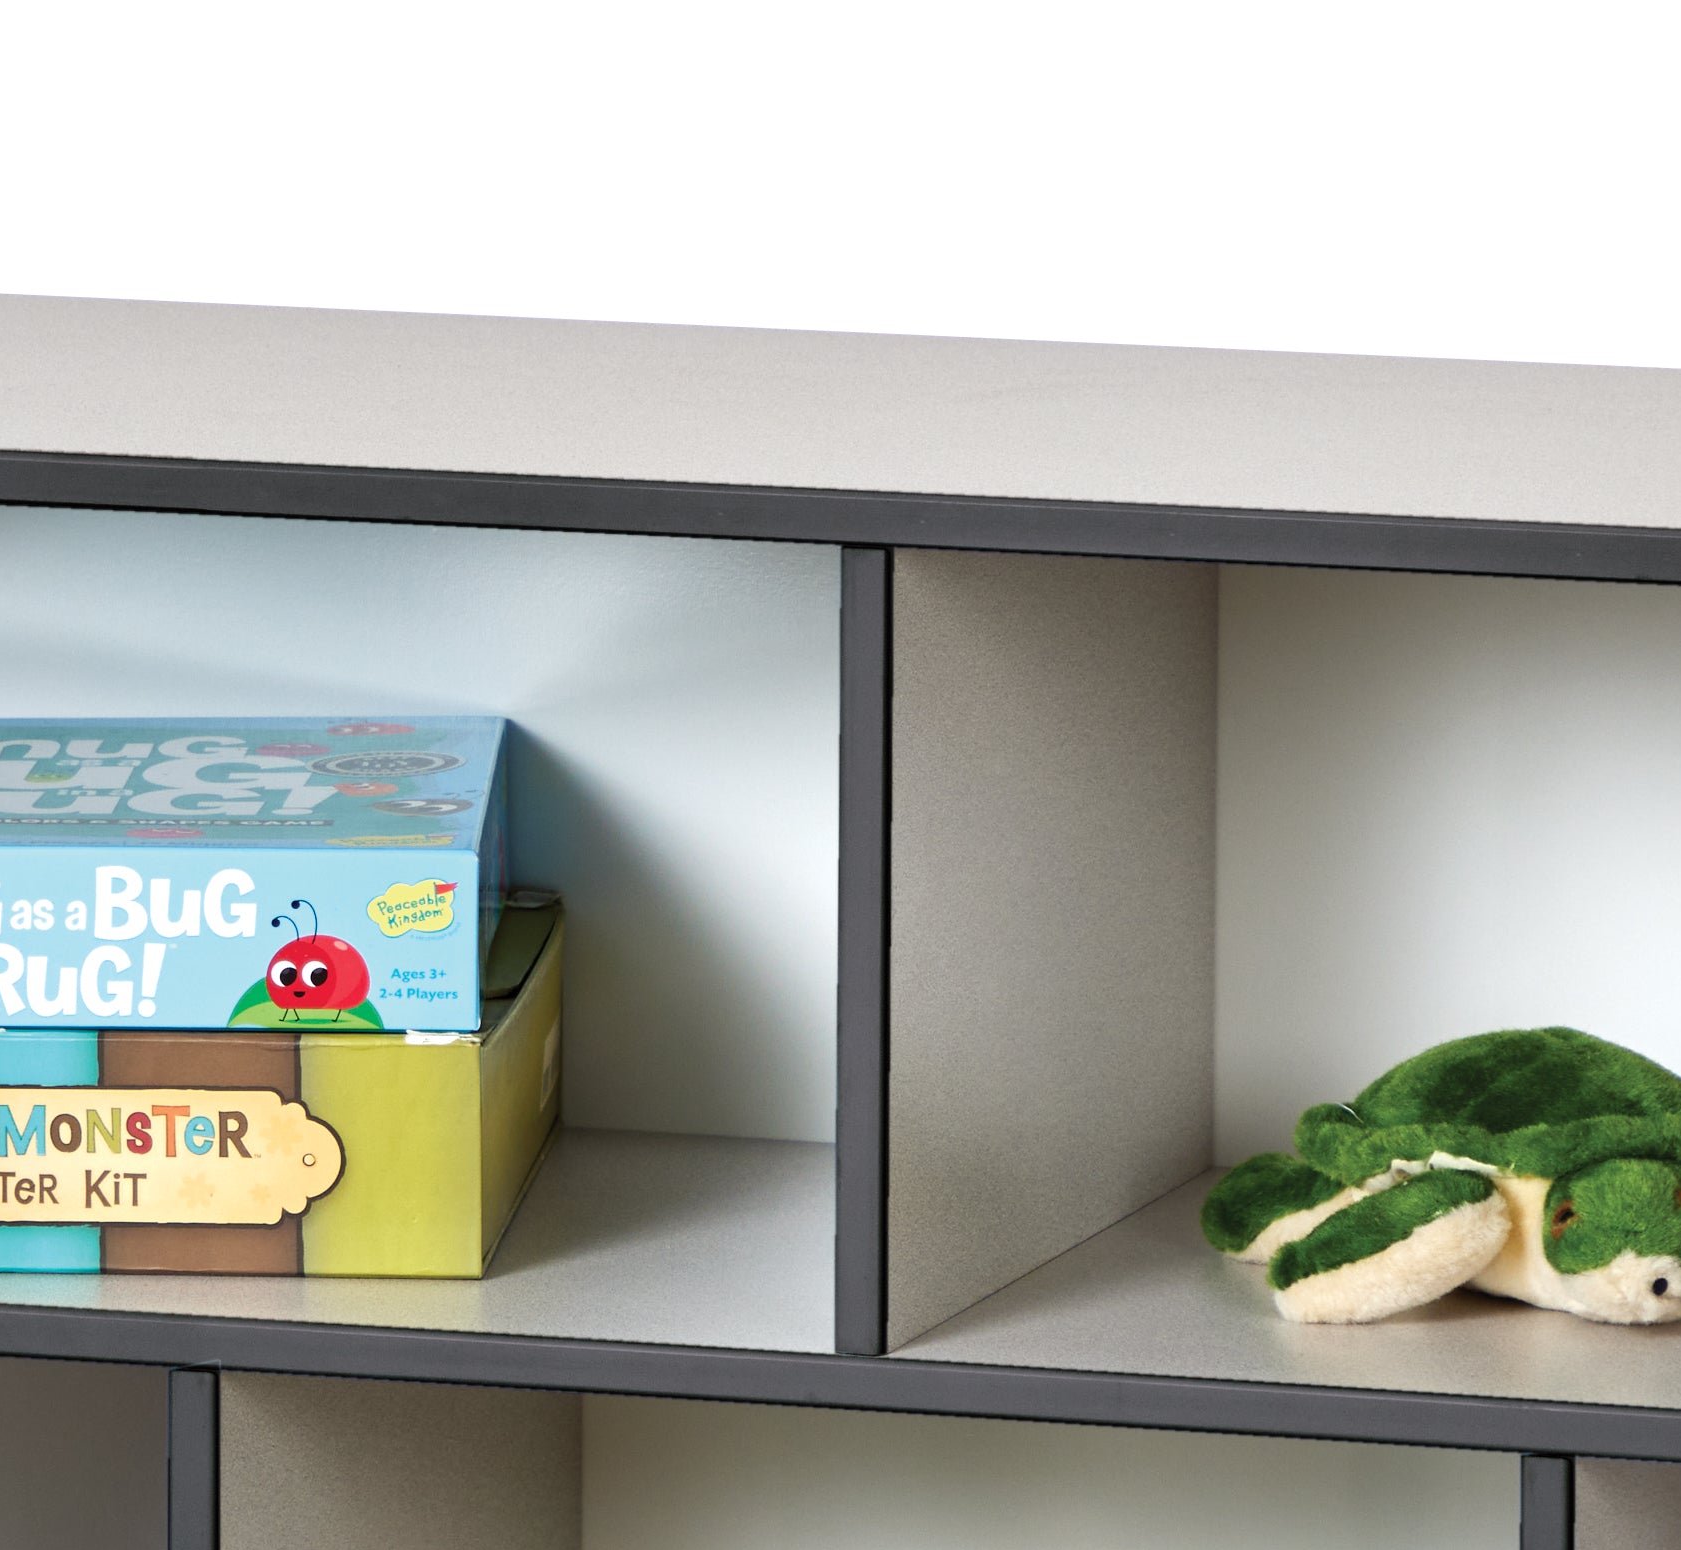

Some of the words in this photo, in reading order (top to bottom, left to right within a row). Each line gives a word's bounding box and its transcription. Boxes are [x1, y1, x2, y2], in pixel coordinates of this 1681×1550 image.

[377, 890, 447, 916] Peaceable
[9, 899, 55, 931] as
[64, 900, 87, 931] a
[388, 907, 444, 929] Kingdom
[391, 968, 426, 983] Ages
[429, 969, 447, 979] 3+
[379, 988, 403, 999] 2-4
[407, 988, 459, 1002] Players
